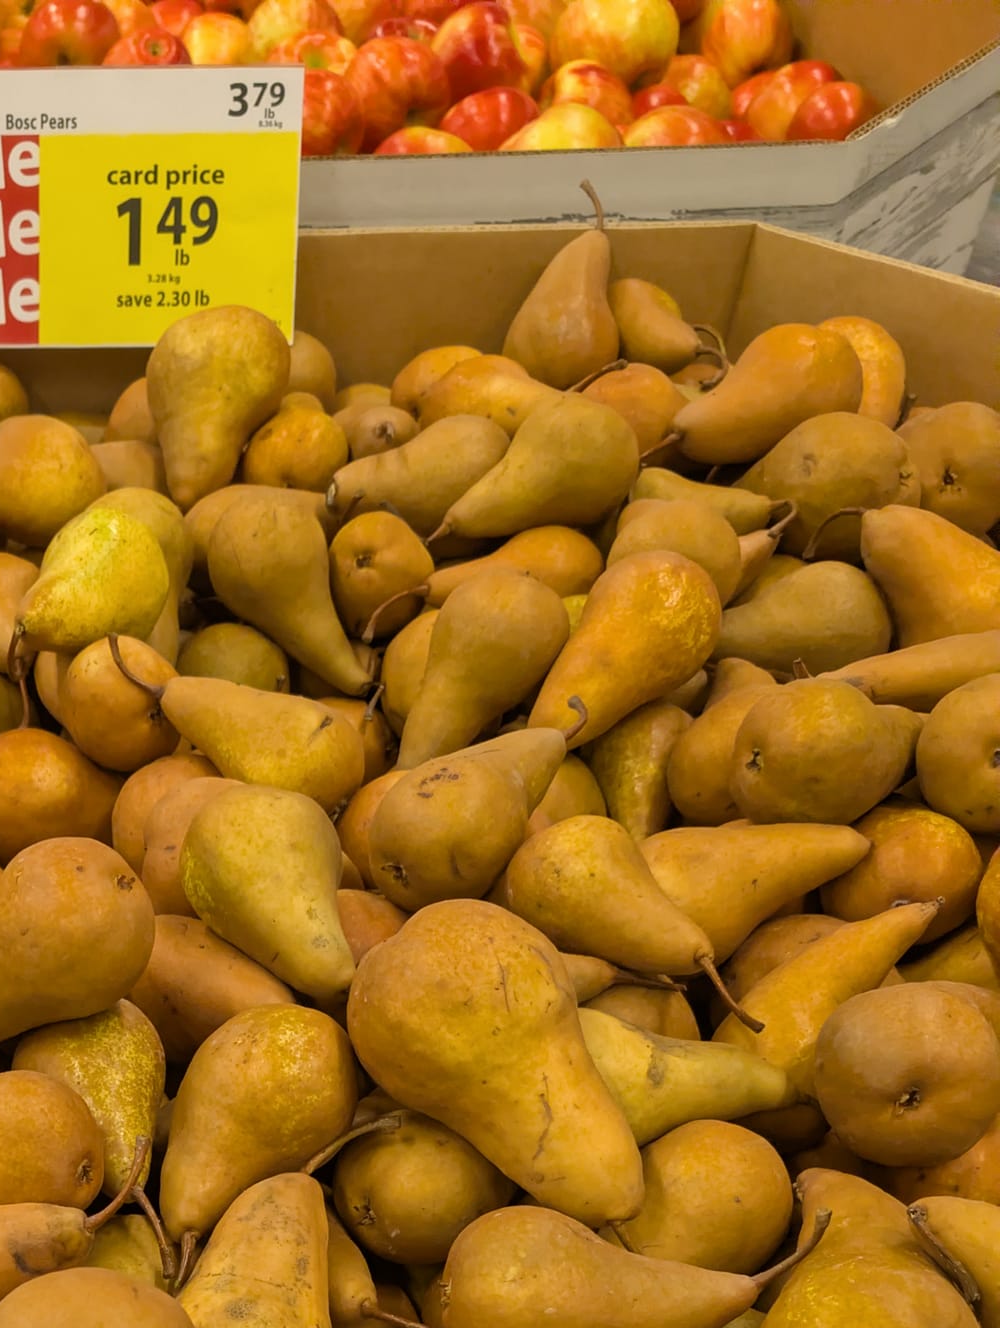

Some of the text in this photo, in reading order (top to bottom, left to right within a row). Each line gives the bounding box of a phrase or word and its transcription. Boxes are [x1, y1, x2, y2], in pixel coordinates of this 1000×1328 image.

[5, 113, 78, 130] Bosc Pears
[264, 108, 276, 119] lb
[107, 164, 225, 190] card price
[175, 249, 190, 267] lb
[147, 273, 181, 284] 3.28 kg
[116, 289, 210, 308] save 2.30 lb
